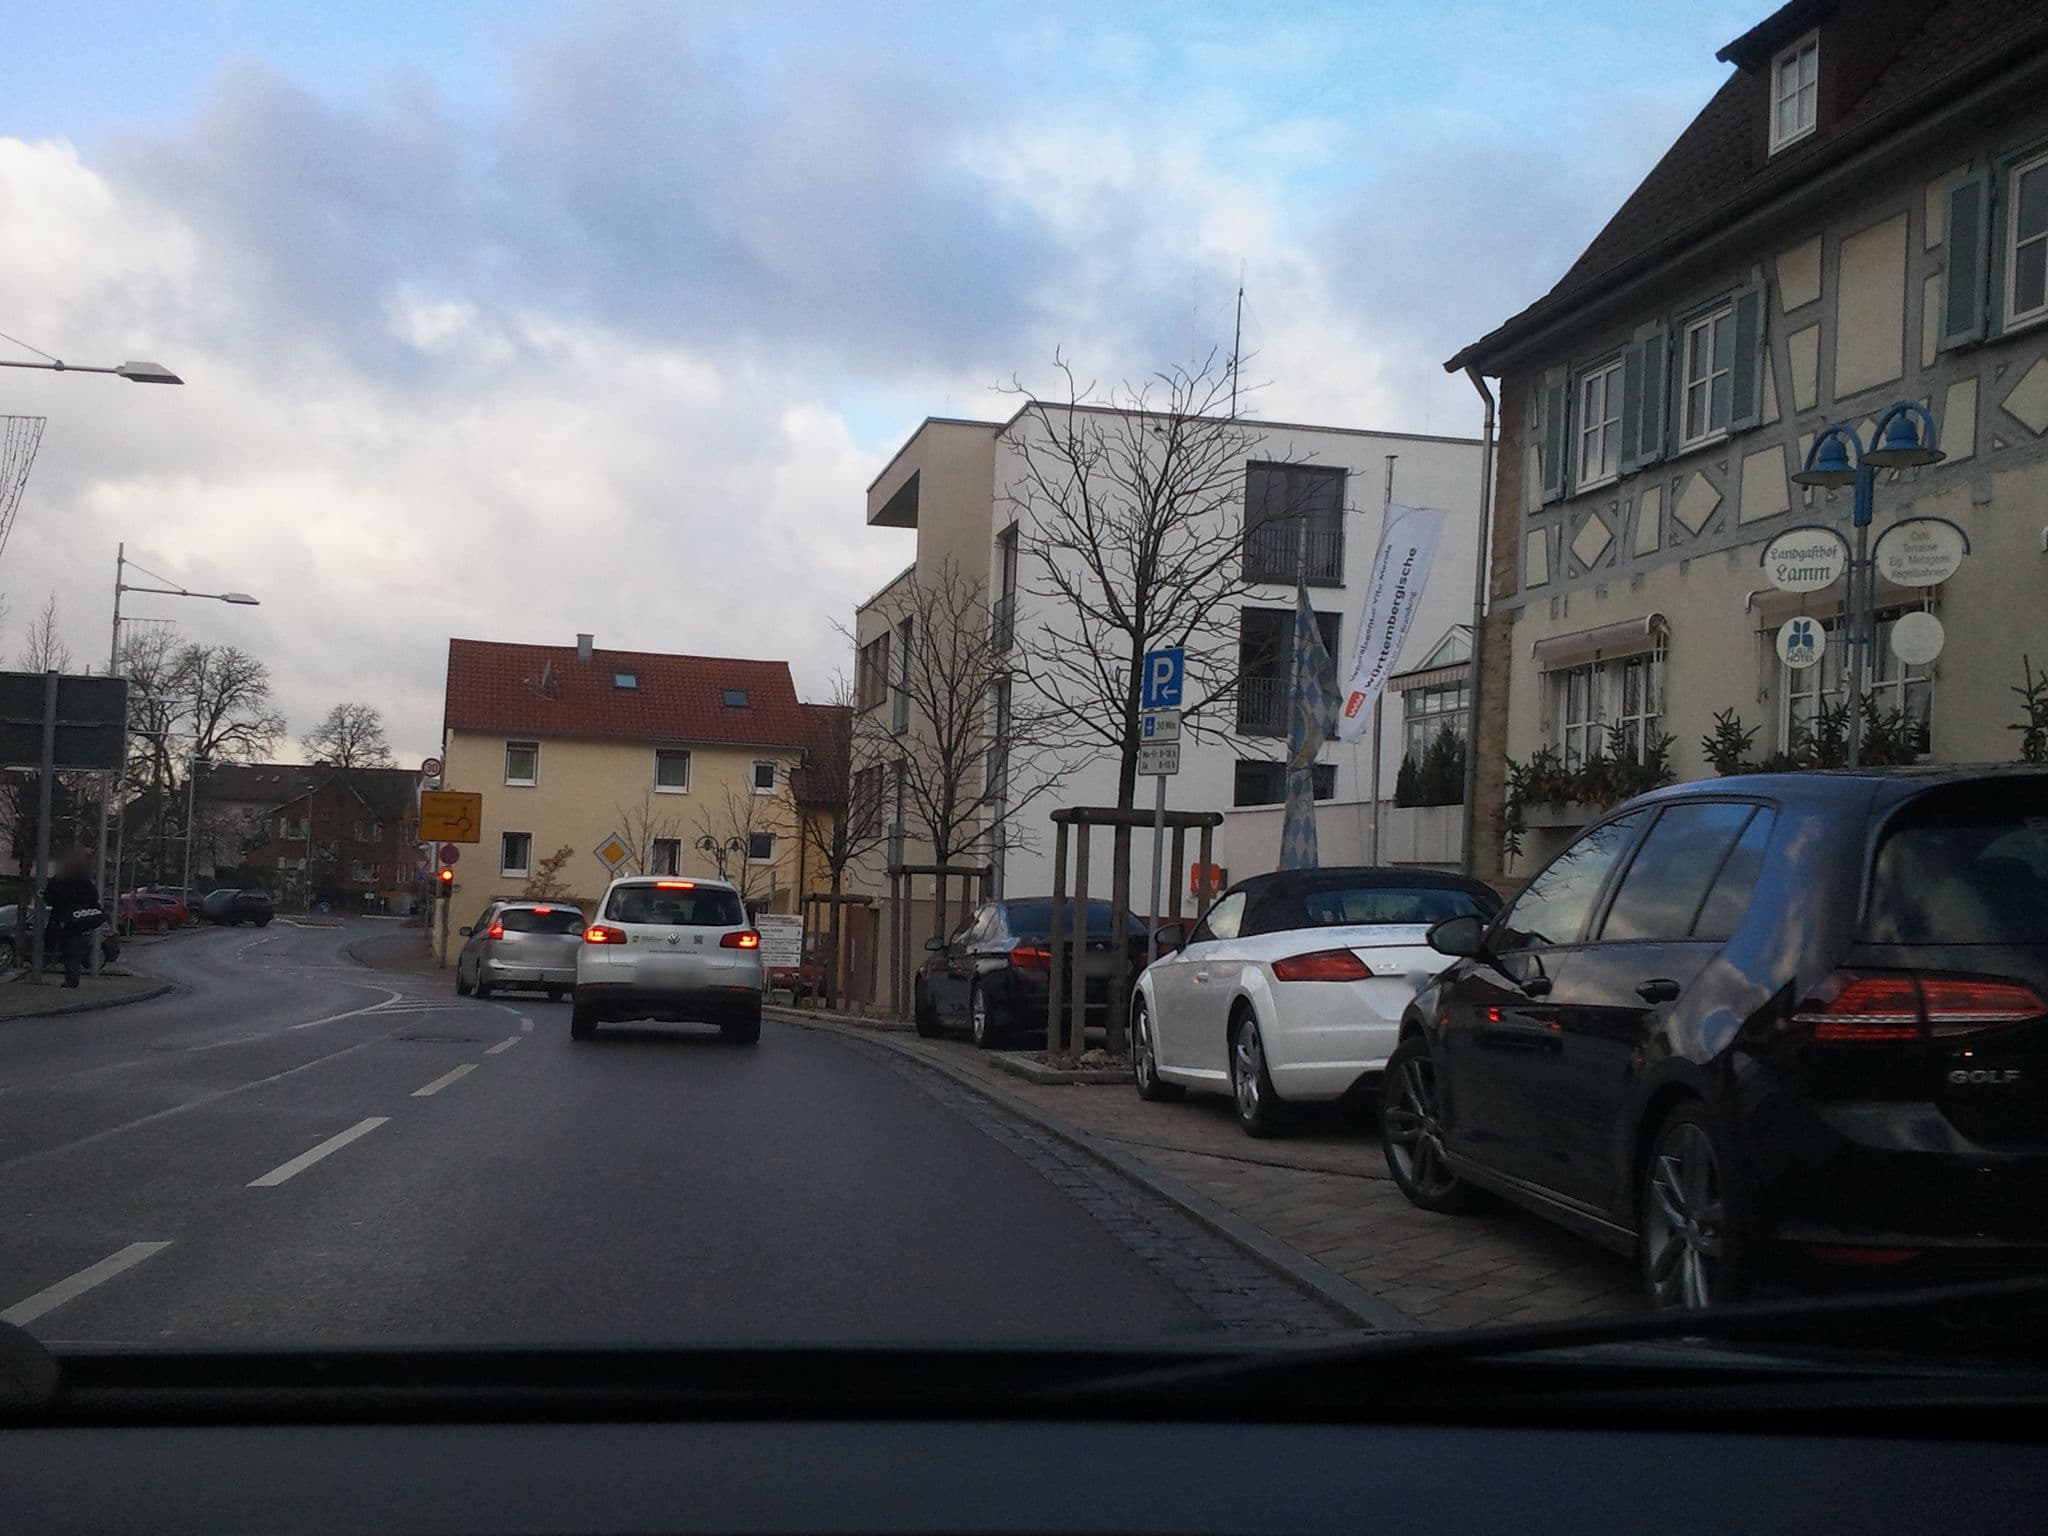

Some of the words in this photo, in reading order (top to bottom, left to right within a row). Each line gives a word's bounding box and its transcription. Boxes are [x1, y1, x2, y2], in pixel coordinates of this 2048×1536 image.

[1776, 564, 1830, 582] Lamm
[1365, 547, 1418, 688] württembergische
[1151, 657, 1175, 701] P
[426, 762, 438, 773] 30
[1949, 1070, 2021, 1084] GOLF
